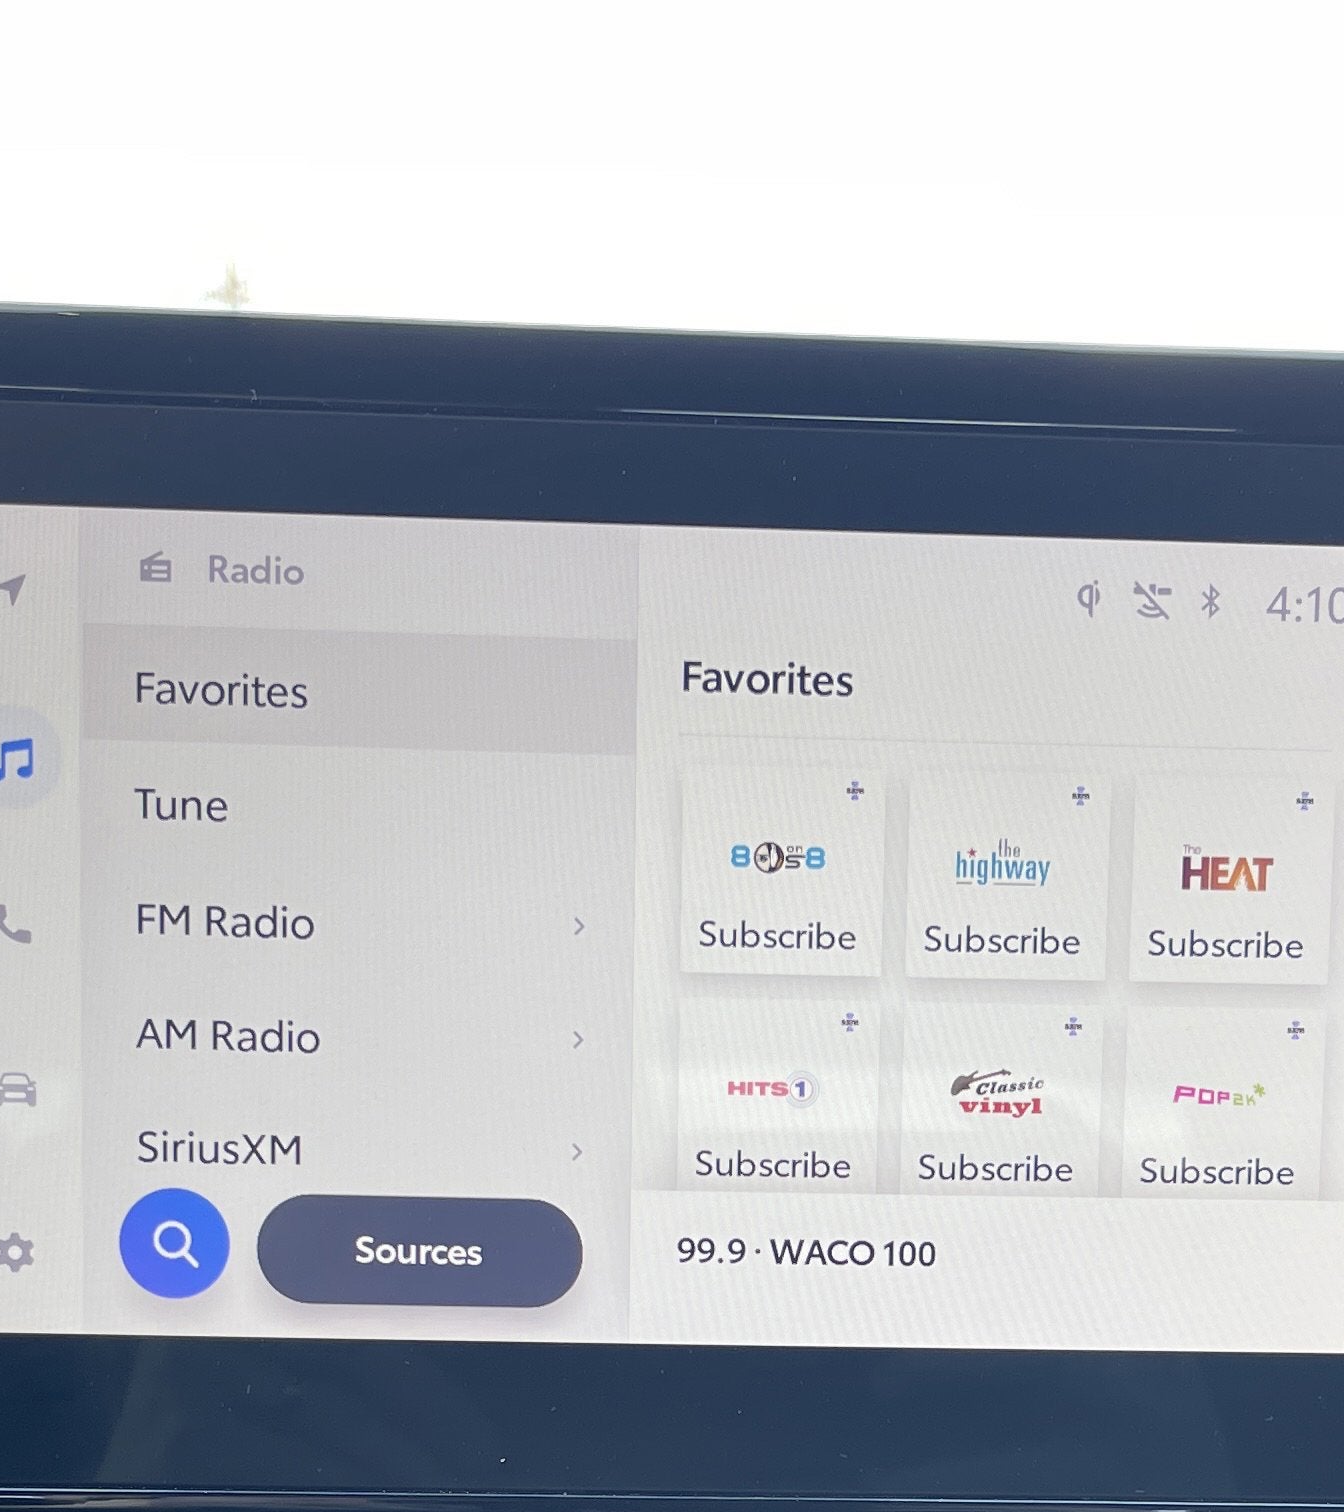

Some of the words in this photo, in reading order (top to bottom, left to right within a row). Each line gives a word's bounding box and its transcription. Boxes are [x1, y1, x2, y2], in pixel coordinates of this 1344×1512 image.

[208, 554, 305, 587] Radio
[135, 671, 309, 711] Favorites
[682, 660, 854, 698] Favorites
[135, 788, 229, 823] Tune
[998, 838, 1021, 858] the
[1183, 844, 1202, 855] The
[956, 848, 1050, 886] highway
[1181, 856, 1274, 891] HEAT
[137, 904, 191, 937] FM
[204, 905, 315, 941] Radio
[699, 920, 856, 950] Subscribe
[924, 925, 1080, 955] Subscribe
[1148, 929, 1304, 959] Subscribe
[136, 1018, 197, 1051] AM
[212, 1019, 321, 1055] Radio
[727, 1081, 788, 1097] HITS
[976, 1076, 1045, 1096] Classic
[959, 1097, 1042, 1118] vinyl
[137, 1130, 302, 1167] SiriusXM
[696, 1149, 851, 1178] Subscribe
[918, 1153, 1073, 1182] Subscribe
[1140, 1157, 1294, 1185] Subscribe
[355, 1235, 483, 1266] Sources
[677, 1237, 746, 1263] 99.9
[770, 1239, 875, 1265] WACO
[883, 1241, 936, 1267] 100
